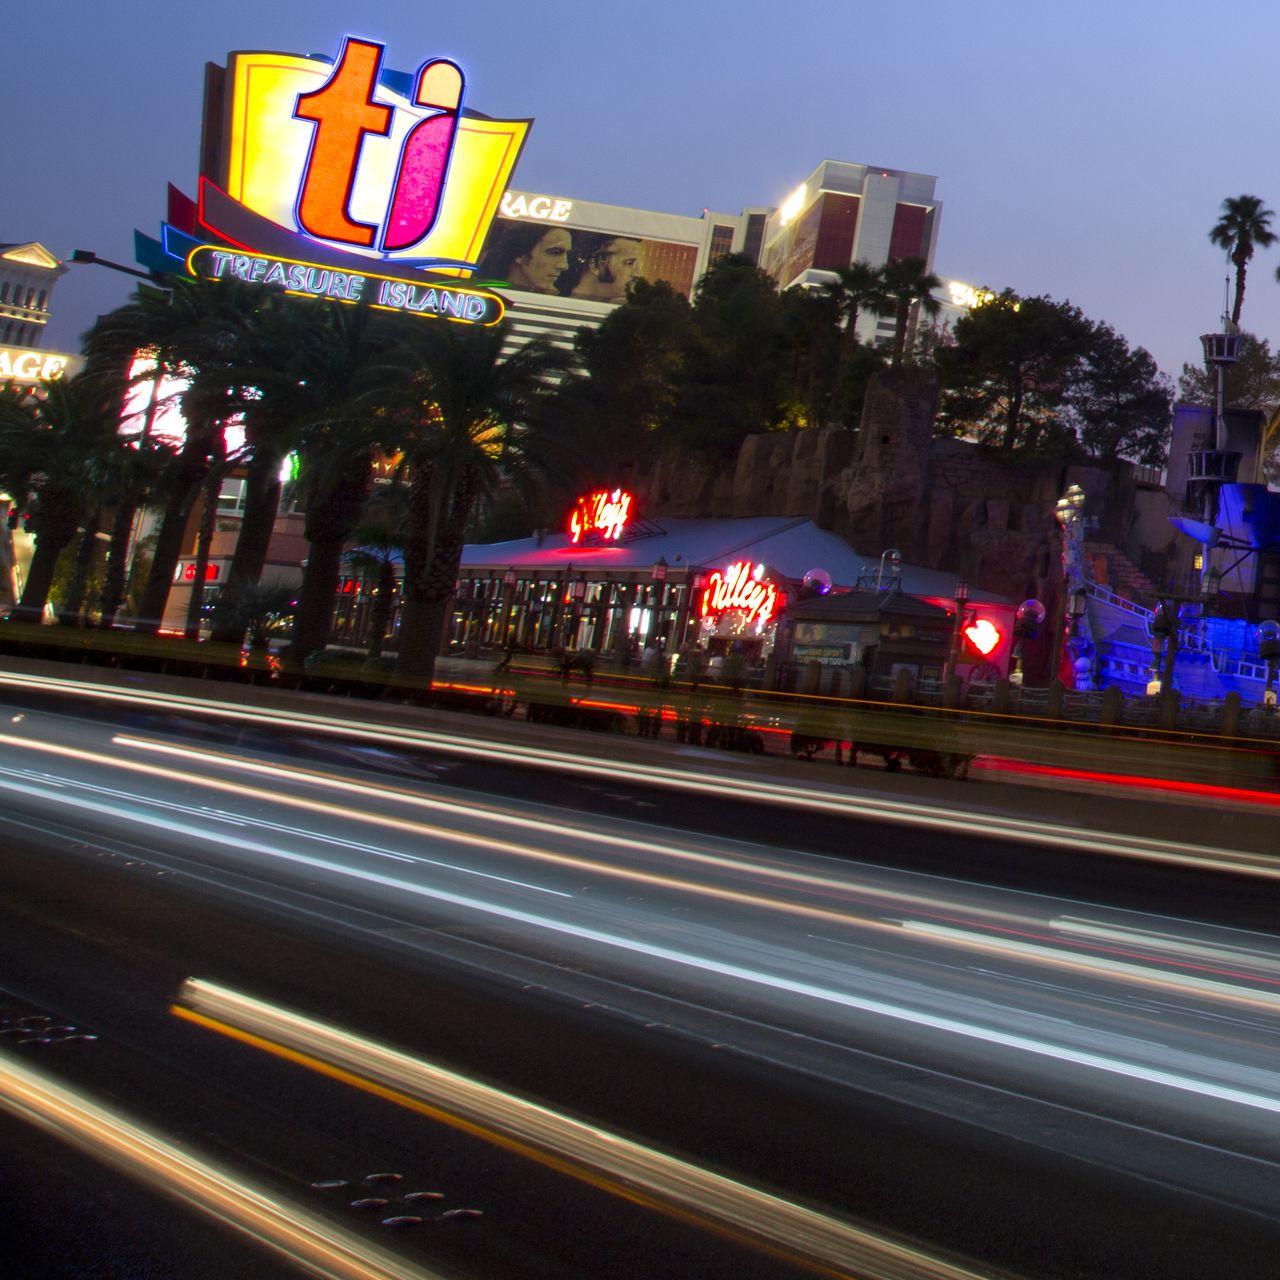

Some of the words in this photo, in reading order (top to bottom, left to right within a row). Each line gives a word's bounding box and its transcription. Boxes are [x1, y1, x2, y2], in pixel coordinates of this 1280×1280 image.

[291, 33, 466, 254] ti
[212, 251, 365, 300] TREASURE
[378, 281, 487, 320] ISLAND
